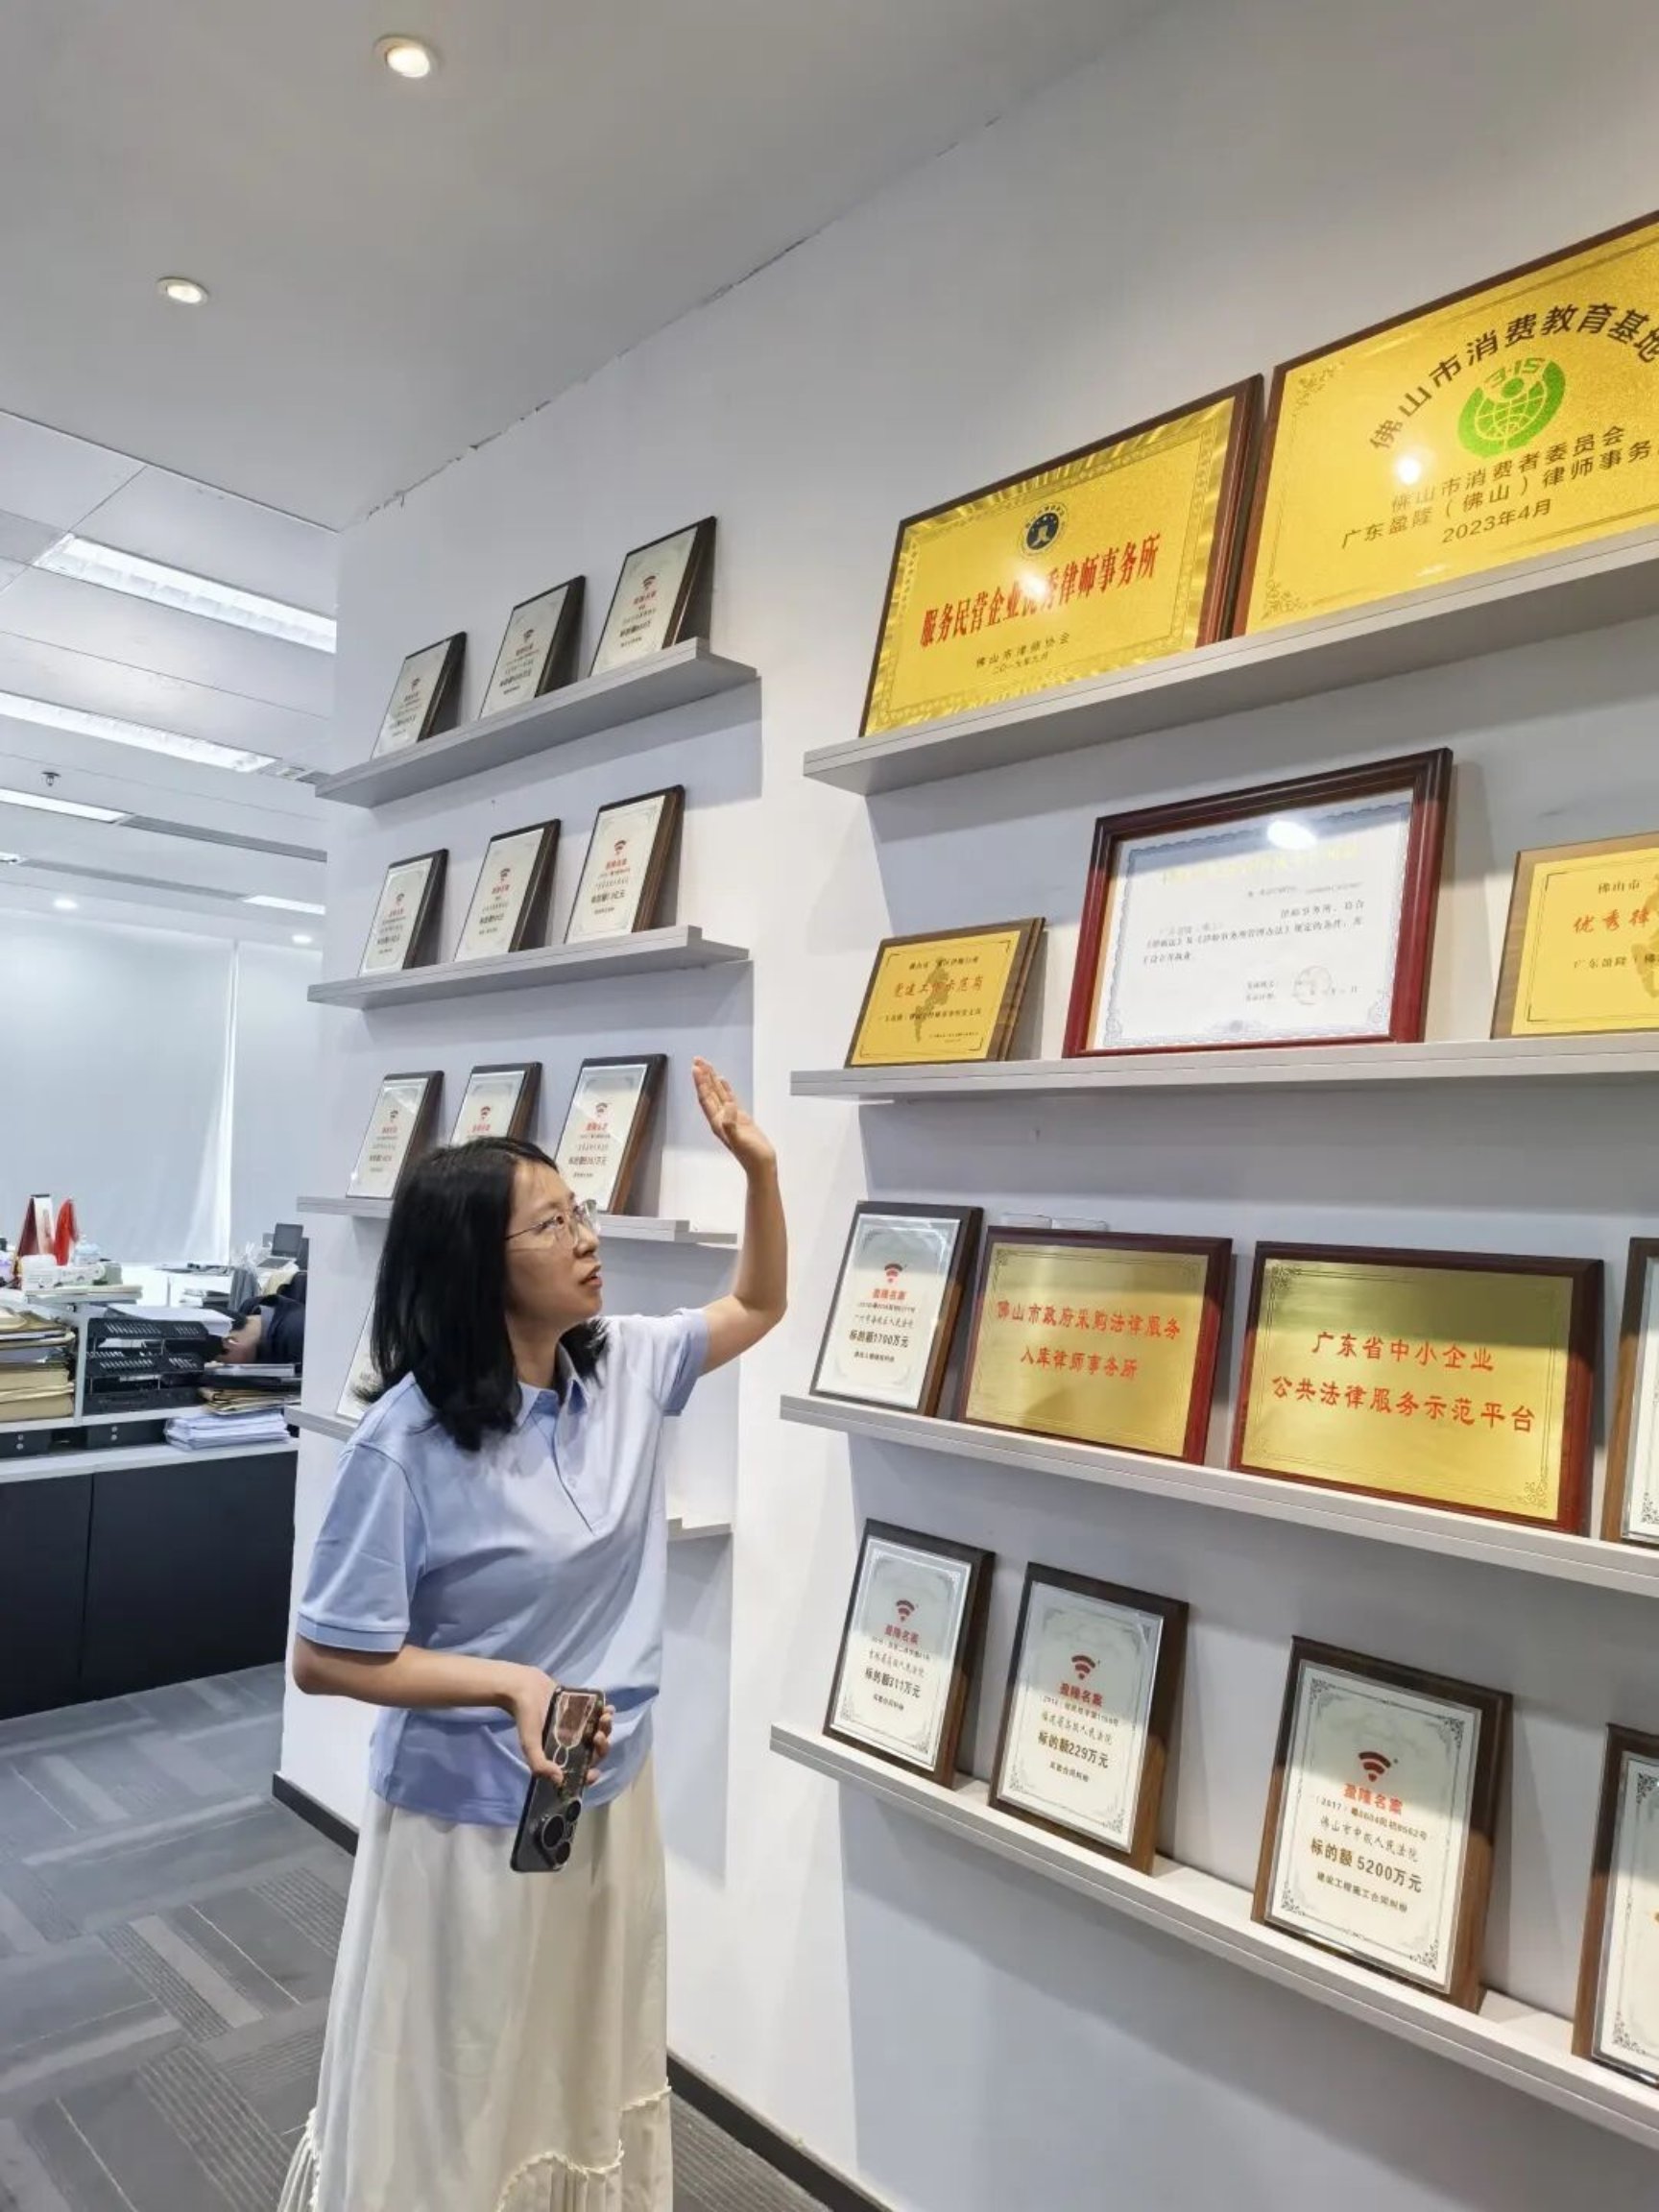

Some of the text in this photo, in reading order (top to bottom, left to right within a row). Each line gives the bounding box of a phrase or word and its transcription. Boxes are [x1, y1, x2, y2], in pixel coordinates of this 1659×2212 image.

[1369, 302, 1659, 450] 佛山市消费教育基地
[1391, 425, 1625, 513] 佛山市消费者委员会
[1341, 440, 1659, 549] 广东盈隆（佛山）律师事务
[1441, 498, 1552, 544] 2023年4月
[998, 1300, 1181, 1340] 佛山市政府采购法律服务
[1020, 1346, 1139, 1379] 入库律师事务所
[1311, 1331, 1495, 1372] 广东省中小企业
[1272, 1375, 1536, 1432] 公共法律服务示范平台
[1038, 1730, 1109, 1768] 标的额229万元
[1344, 1783, 1404, 1815] 盈隆名案
[1310, 1838, 1423, 1893] 标的额 5200万元
